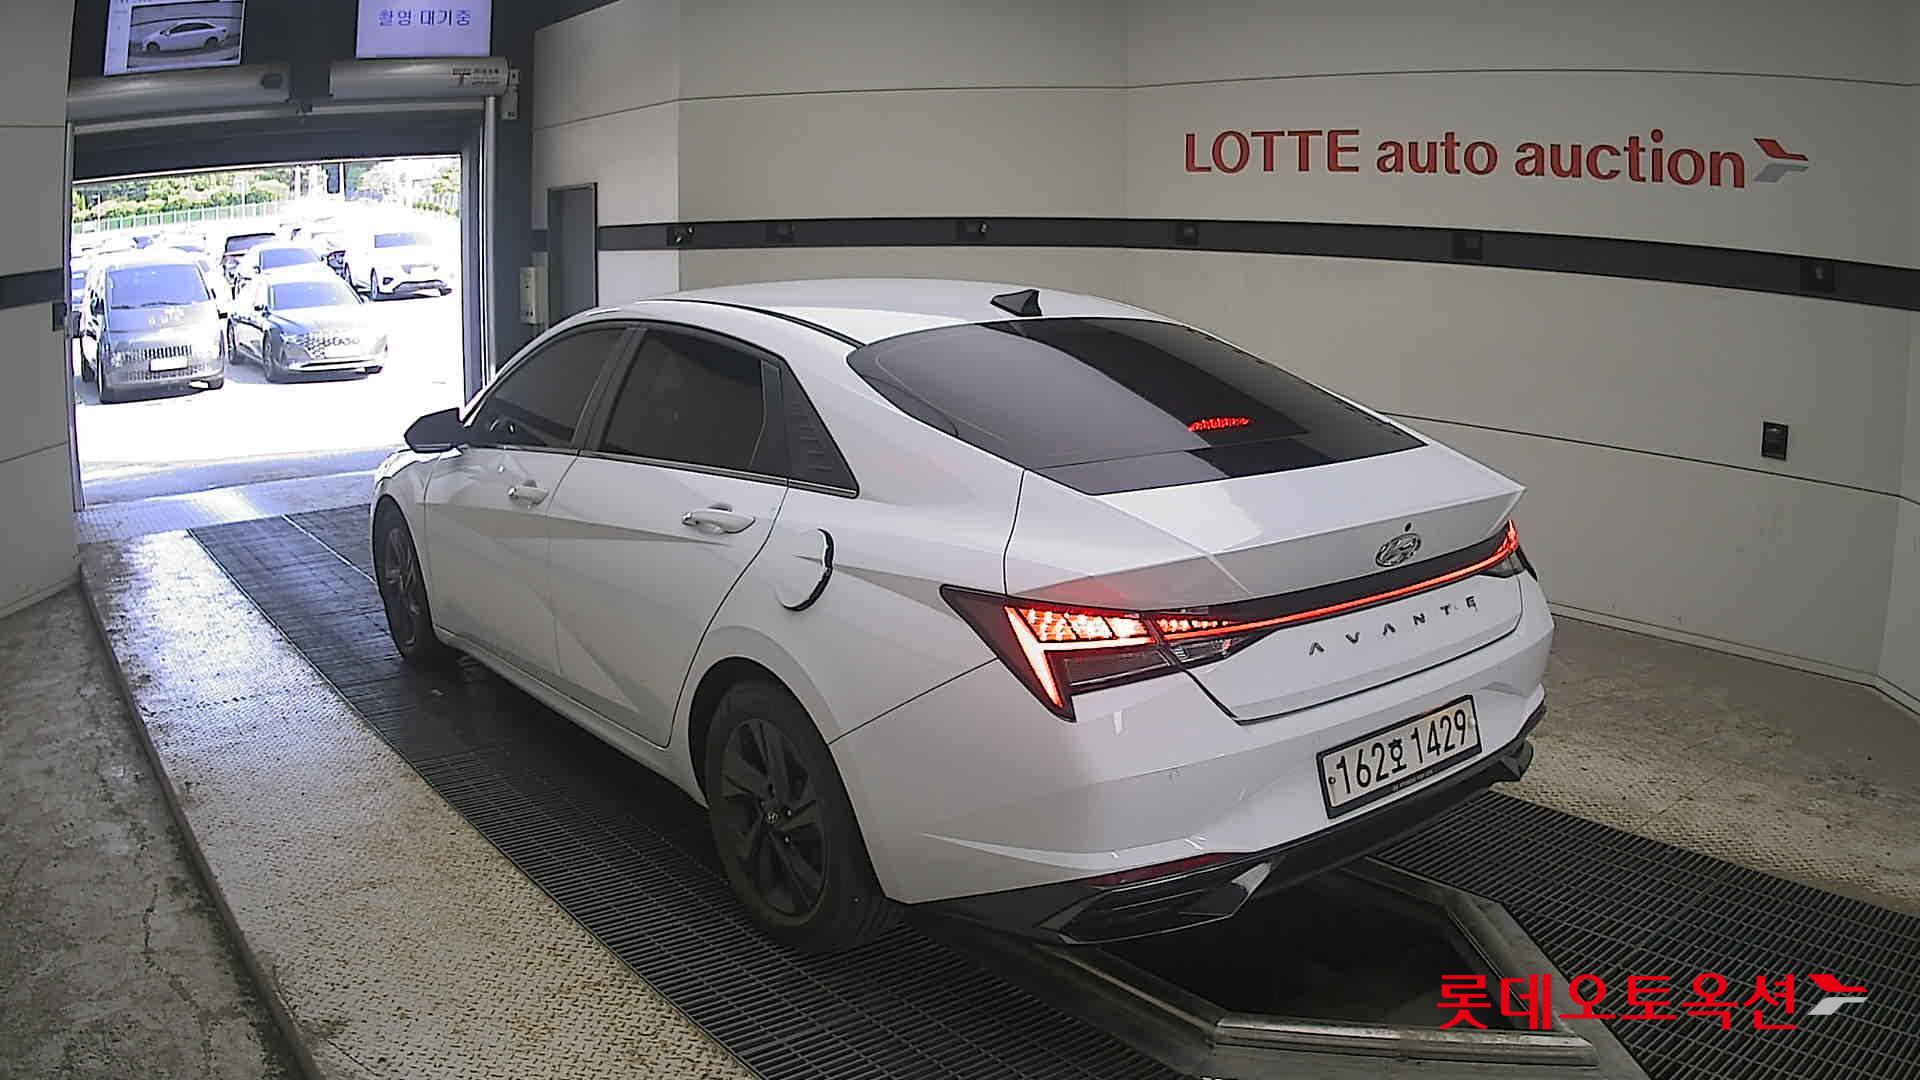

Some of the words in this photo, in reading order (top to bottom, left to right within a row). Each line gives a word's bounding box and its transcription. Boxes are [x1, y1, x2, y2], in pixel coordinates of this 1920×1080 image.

[420, 8, 471, 26] 대기중
[1185, 130, 1360, 174] LOTTE
[1376, 132, 1498, 175] auto
[1515, 129, 1745, 188] auction
[1309, 595, 1478, 656] AVANTE
[1336, 739, 1407, 794] 162호
[1410, 709, 1466, 764] 1429
